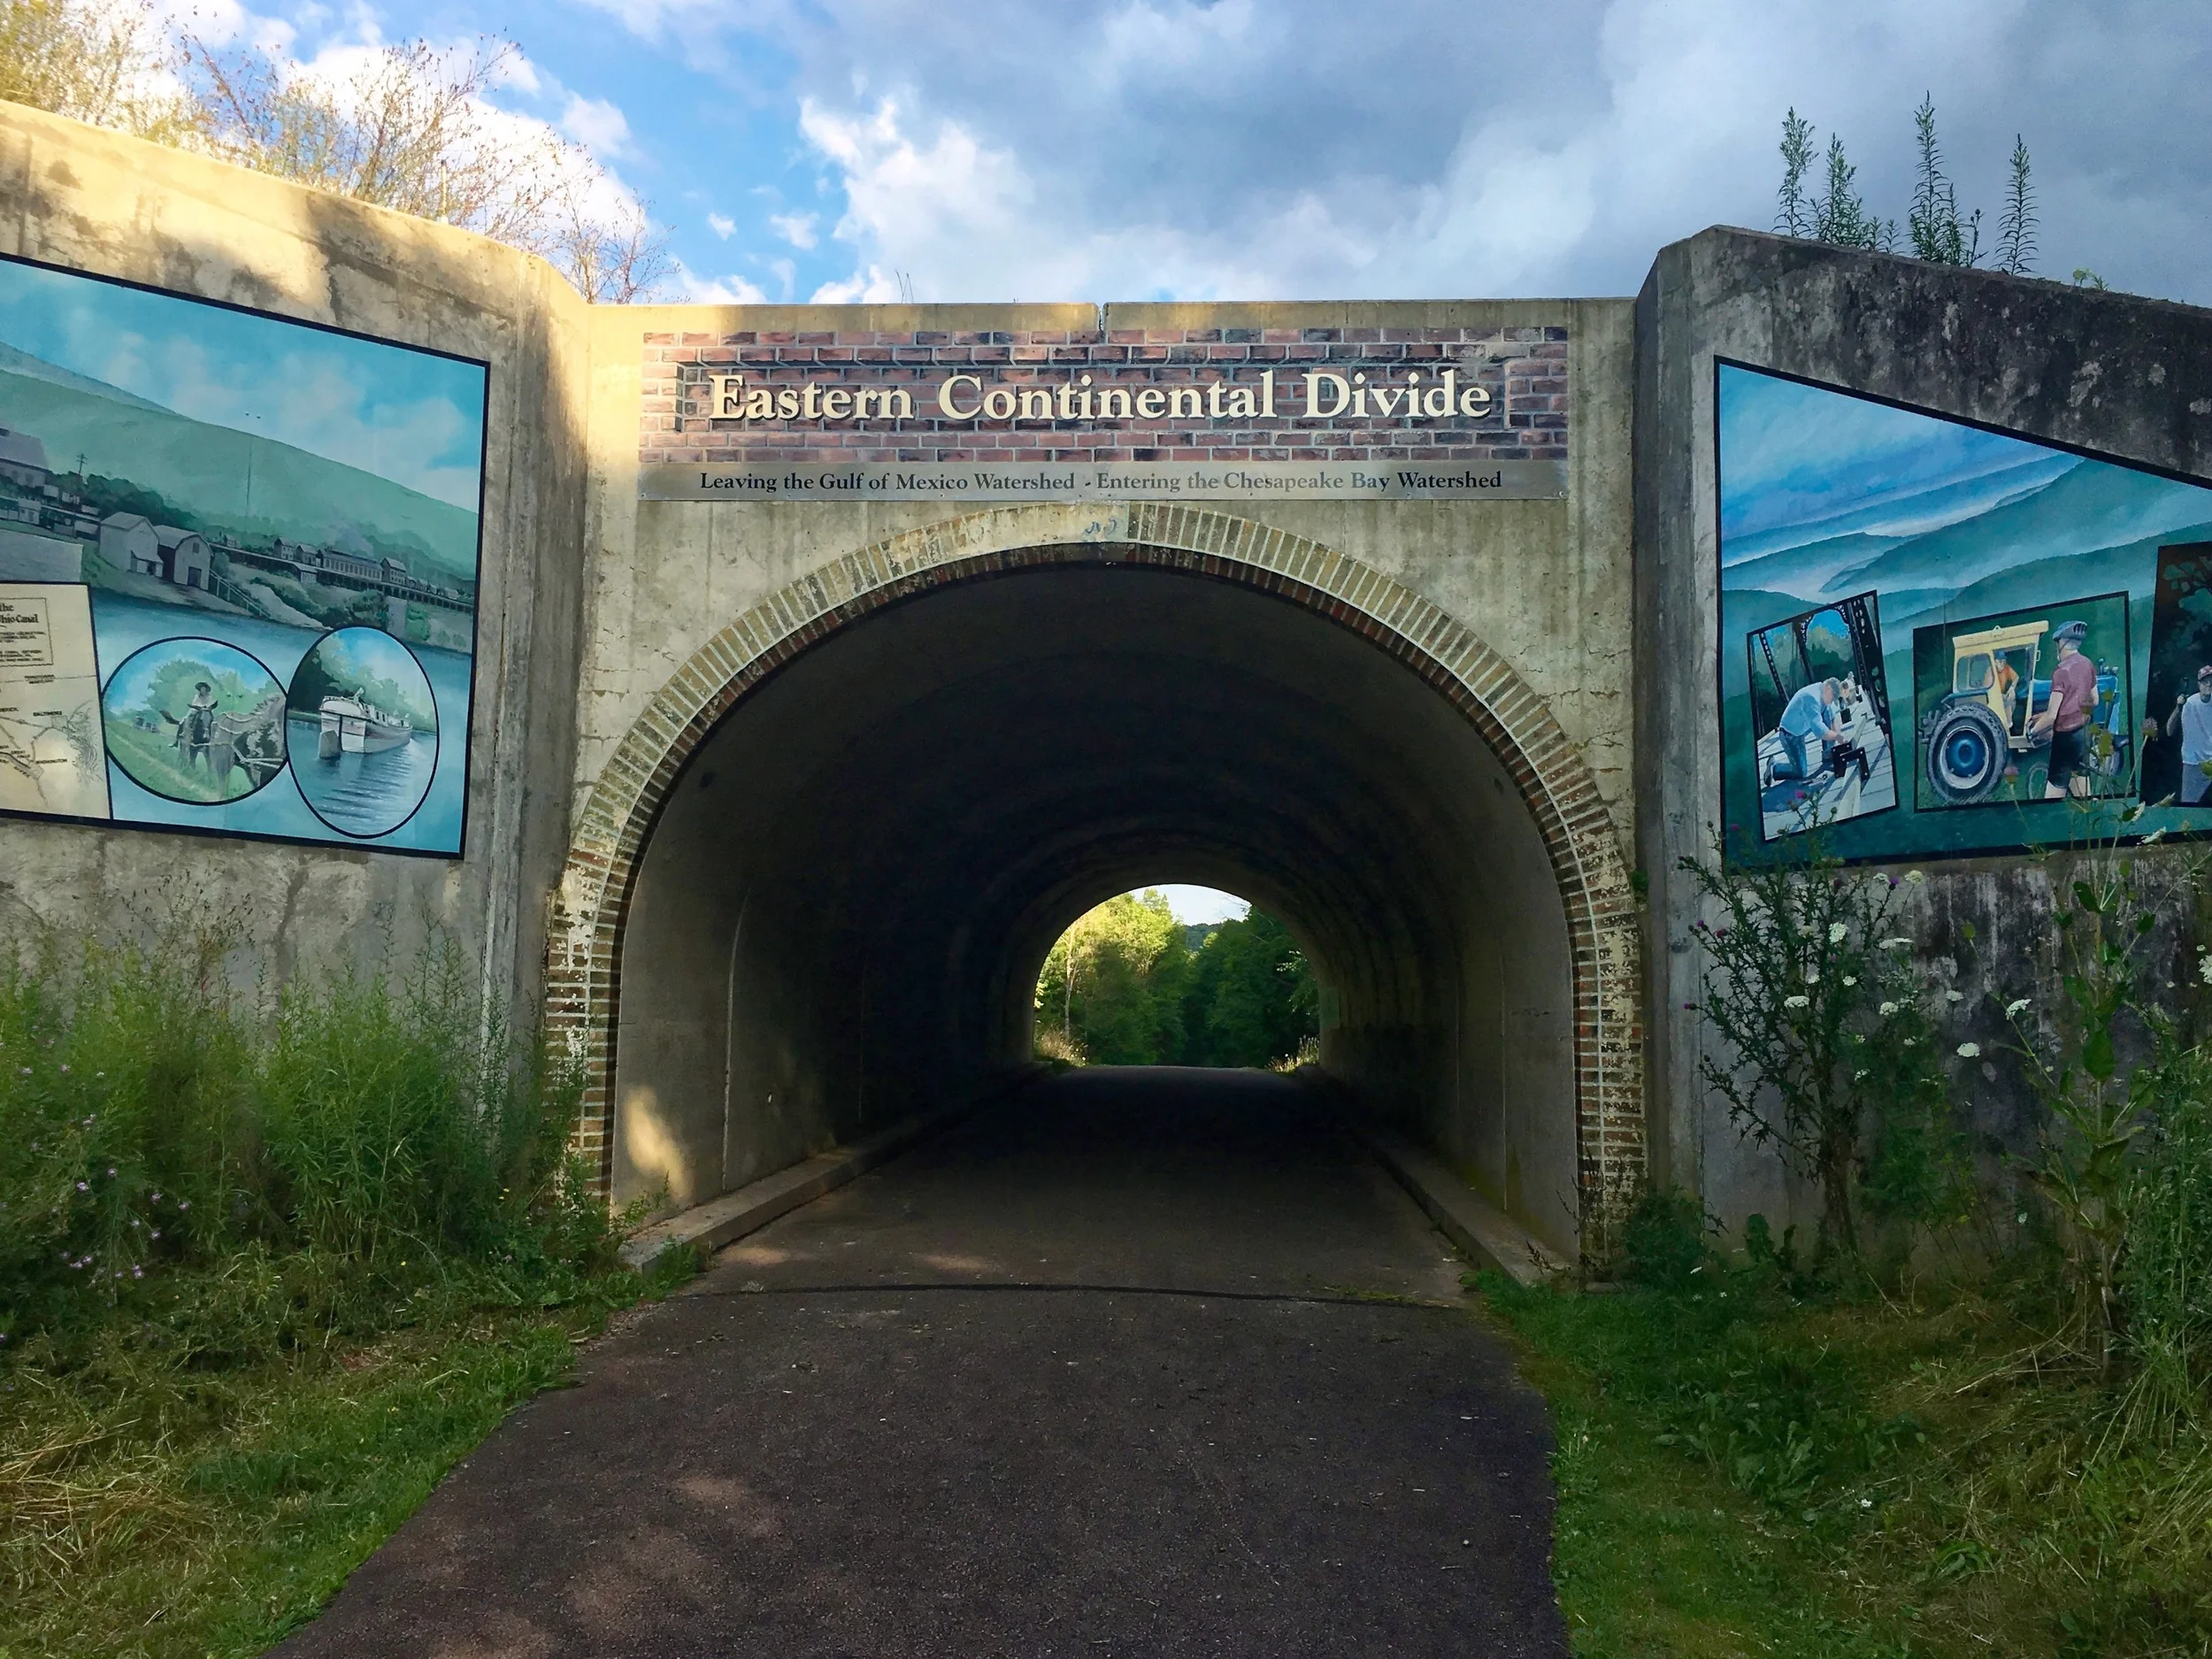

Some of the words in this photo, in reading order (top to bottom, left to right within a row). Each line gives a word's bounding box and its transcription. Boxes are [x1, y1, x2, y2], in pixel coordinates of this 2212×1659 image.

[709, 374, 915, 420] Eastern
[938, 370, 1278, 420] Continental
[1302, 369, 1492, 419] Divide
[701, 472, 777, 493] Leaving
[783, 472, 814, 490] the
[819, 472, 864, 490] Gulf
[869, 472, 890, 490] of
[896, 472, 968, 490] Mexico
[973, 472, 1075, 489] Watershed
[1096, 472, 1181, 492] Entering
[1187, 472, 1219, 489] the
[1224, 472, 1344, 492] Chesapeake
[1351, 472, 1390, 492] Bay
[1397, 471, 1502, 488] Watershed
[16, 614, 39, 623] Canal
